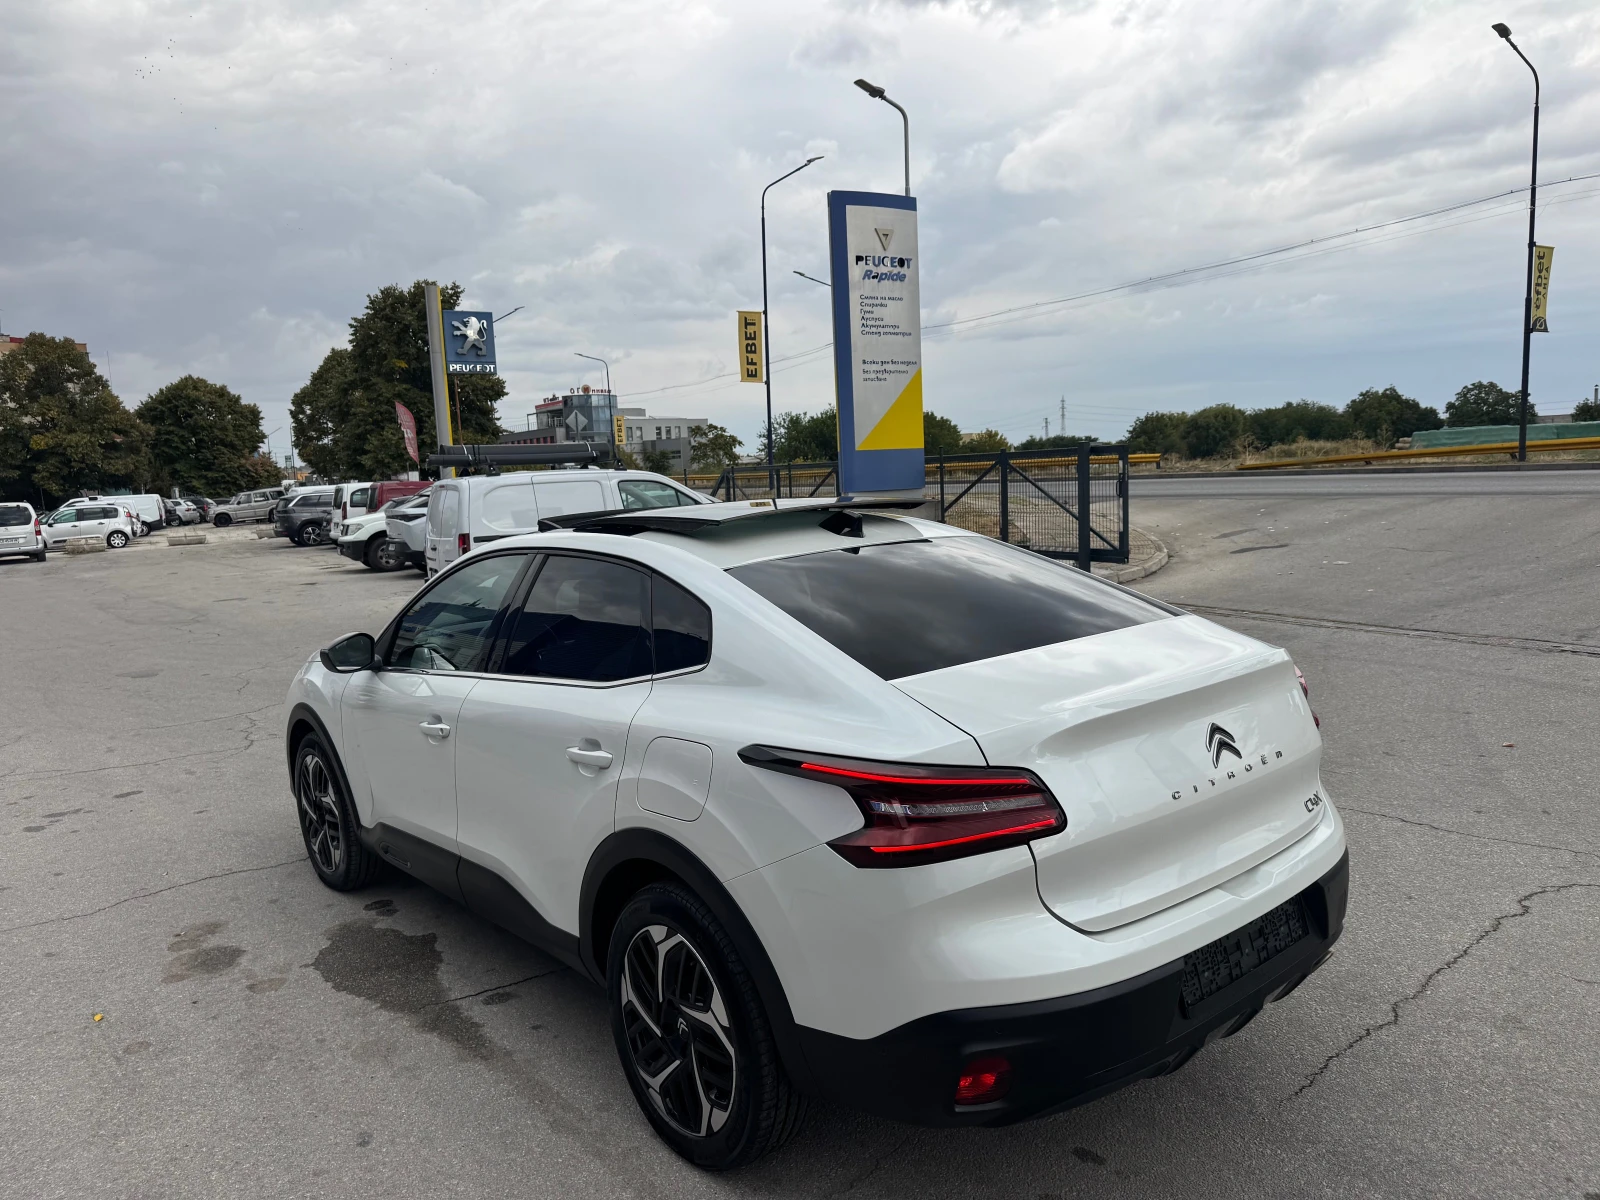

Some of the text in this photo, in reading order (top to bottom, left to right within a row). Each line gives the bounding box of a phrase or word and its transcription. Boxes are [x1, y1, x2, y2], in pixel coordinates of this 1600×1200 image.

[855, 255, 912, 269] PEUGEOT
[862, 270, 906, 282] Rapide
[1534, 250, 1546, 311] efbet
[744, 316, 758, 378] EFBET
[449, 364, 496, 372] PEUGEOT
[1171, 750, 1283, 800] CITROËN
